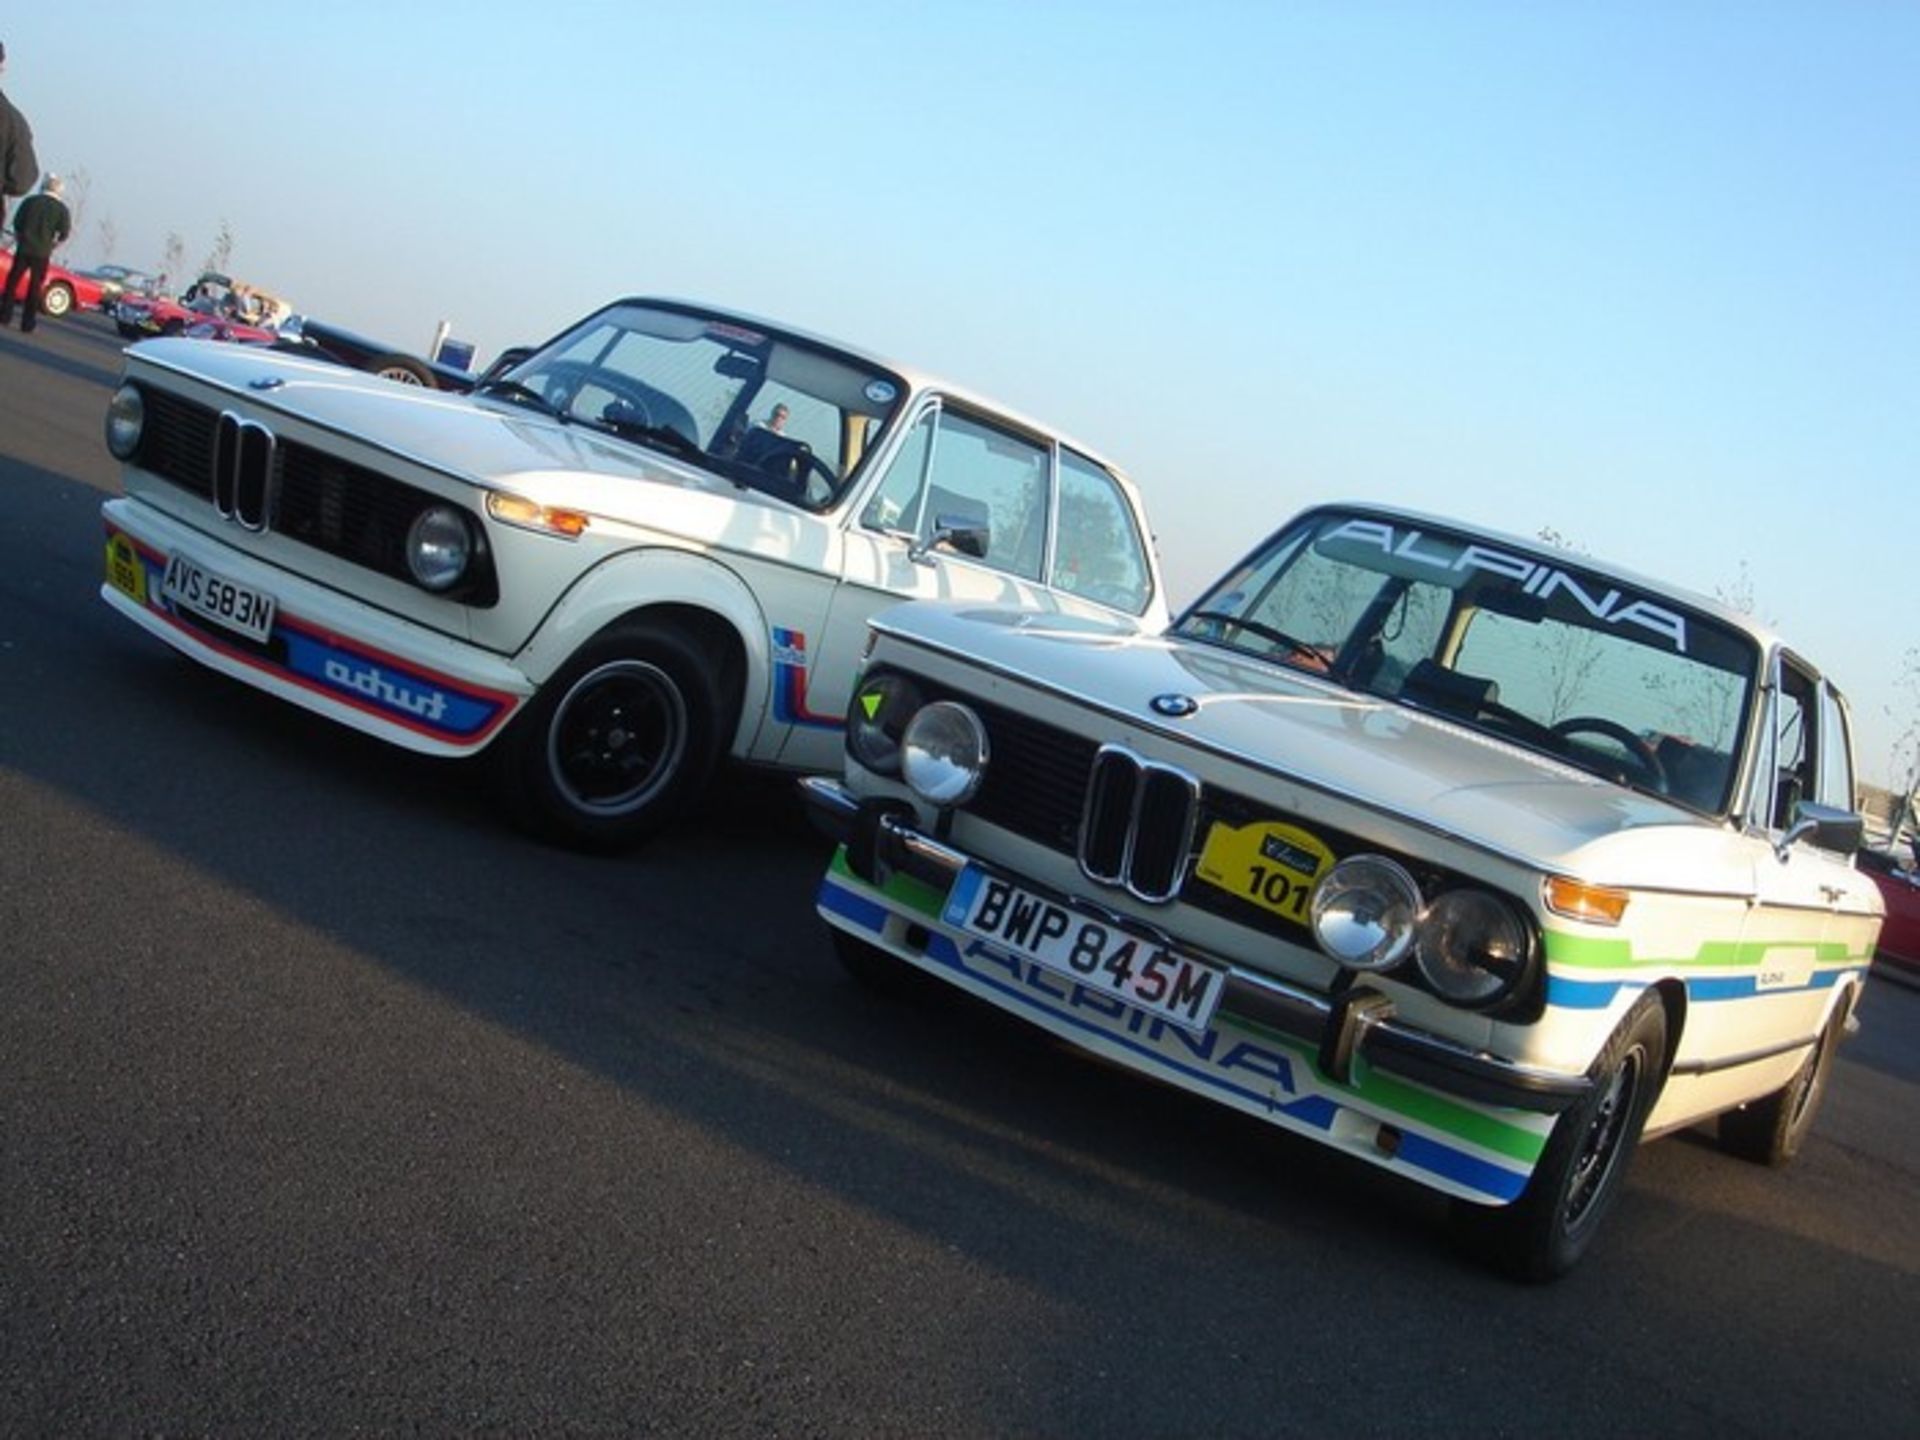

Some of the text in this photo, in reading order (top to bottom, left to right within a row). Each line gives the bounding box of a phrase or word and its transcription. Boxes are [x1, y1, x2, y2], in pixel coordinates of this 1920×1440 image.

[166, 556, 202, 601] AVS
[205, 578, 270, 632] 583N
[1319, 519, 1687, 653] ALPINA
[1249, 866, 1310, 914] 101
[972, 881, 1212, 1020] BWP 845M
